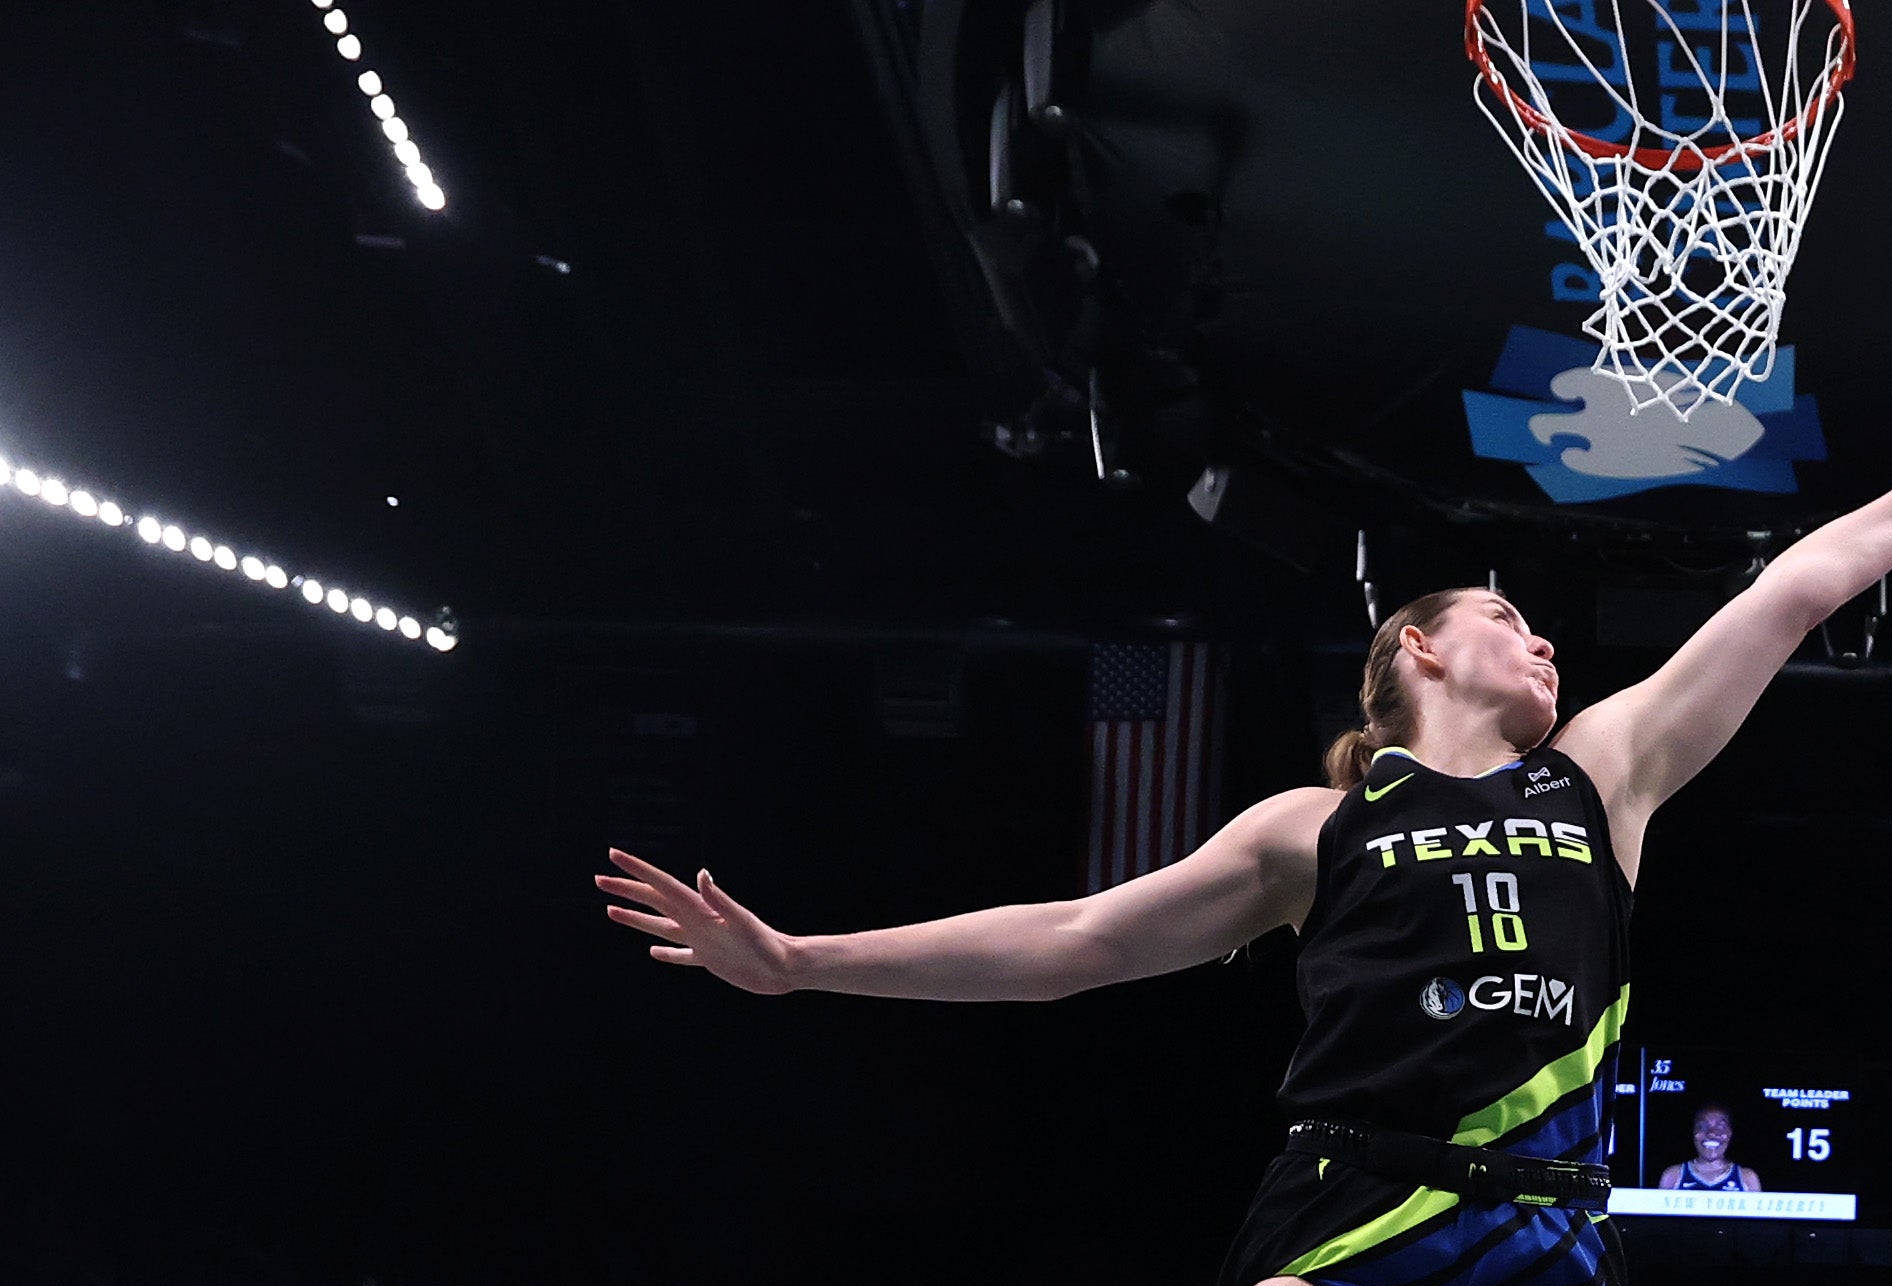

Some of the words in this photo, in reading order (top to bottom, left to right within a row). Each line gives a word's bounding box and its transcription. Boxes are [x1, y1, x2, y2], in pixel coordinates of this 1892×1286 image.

[1524, 776, 1571, 799] Albert
[1366, 818, 1593, 869] TEXAS
[1469, 972, 1575, 1027] GEM
[1651, 1060, 1672, 1074] 35
[1649, 1077, 1686, 1092] Jones
[1763, 1088, 1799, 1098] TEAM
[1800, 1090, 1850, 1100] LEADER
[1782, 1098, 1830, 1109] POINTS
[1786, 1127, 1831, 1161] 15
